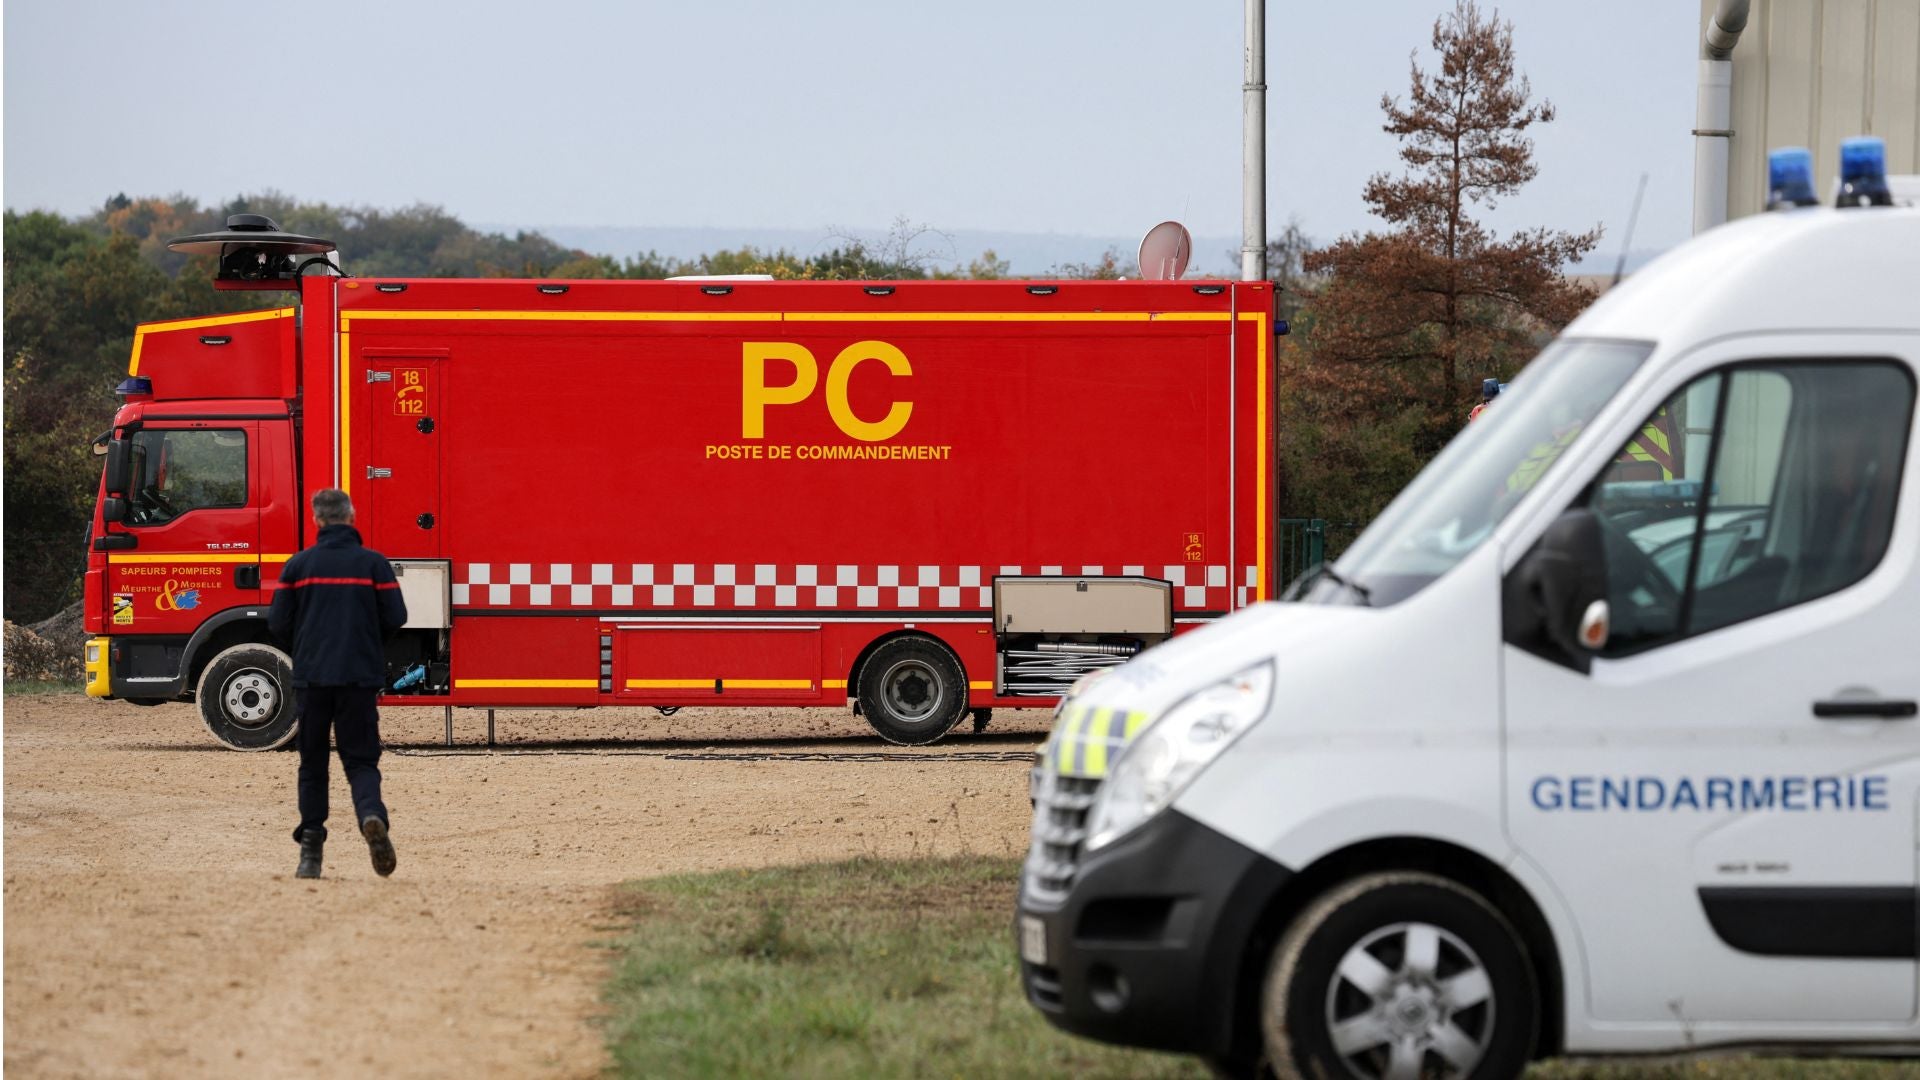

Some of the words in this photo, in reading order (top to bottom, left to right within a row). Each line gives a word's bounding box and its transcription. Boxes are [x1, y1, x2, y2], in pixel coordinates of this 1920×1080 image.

[402, 370, 420, 385] 18
[742, 340, 914, 442] PC
[398, 399, 423, 414] 112
[705, 445, 763, 459] POSTE
[768, 445, 791, 459] DE
[796, 445, 951, 460] COMMANDEMENT
[1188, 534, 1199, 543] 18
[1186, 551, 1201, 560] 112
[121, 567, 167, 575] SAPEURS
[172, 567, 222, 575] POMPIERS
[155, 579, 184, 611] &
[1531, 775, 1889, 811] GENDARMERIE
